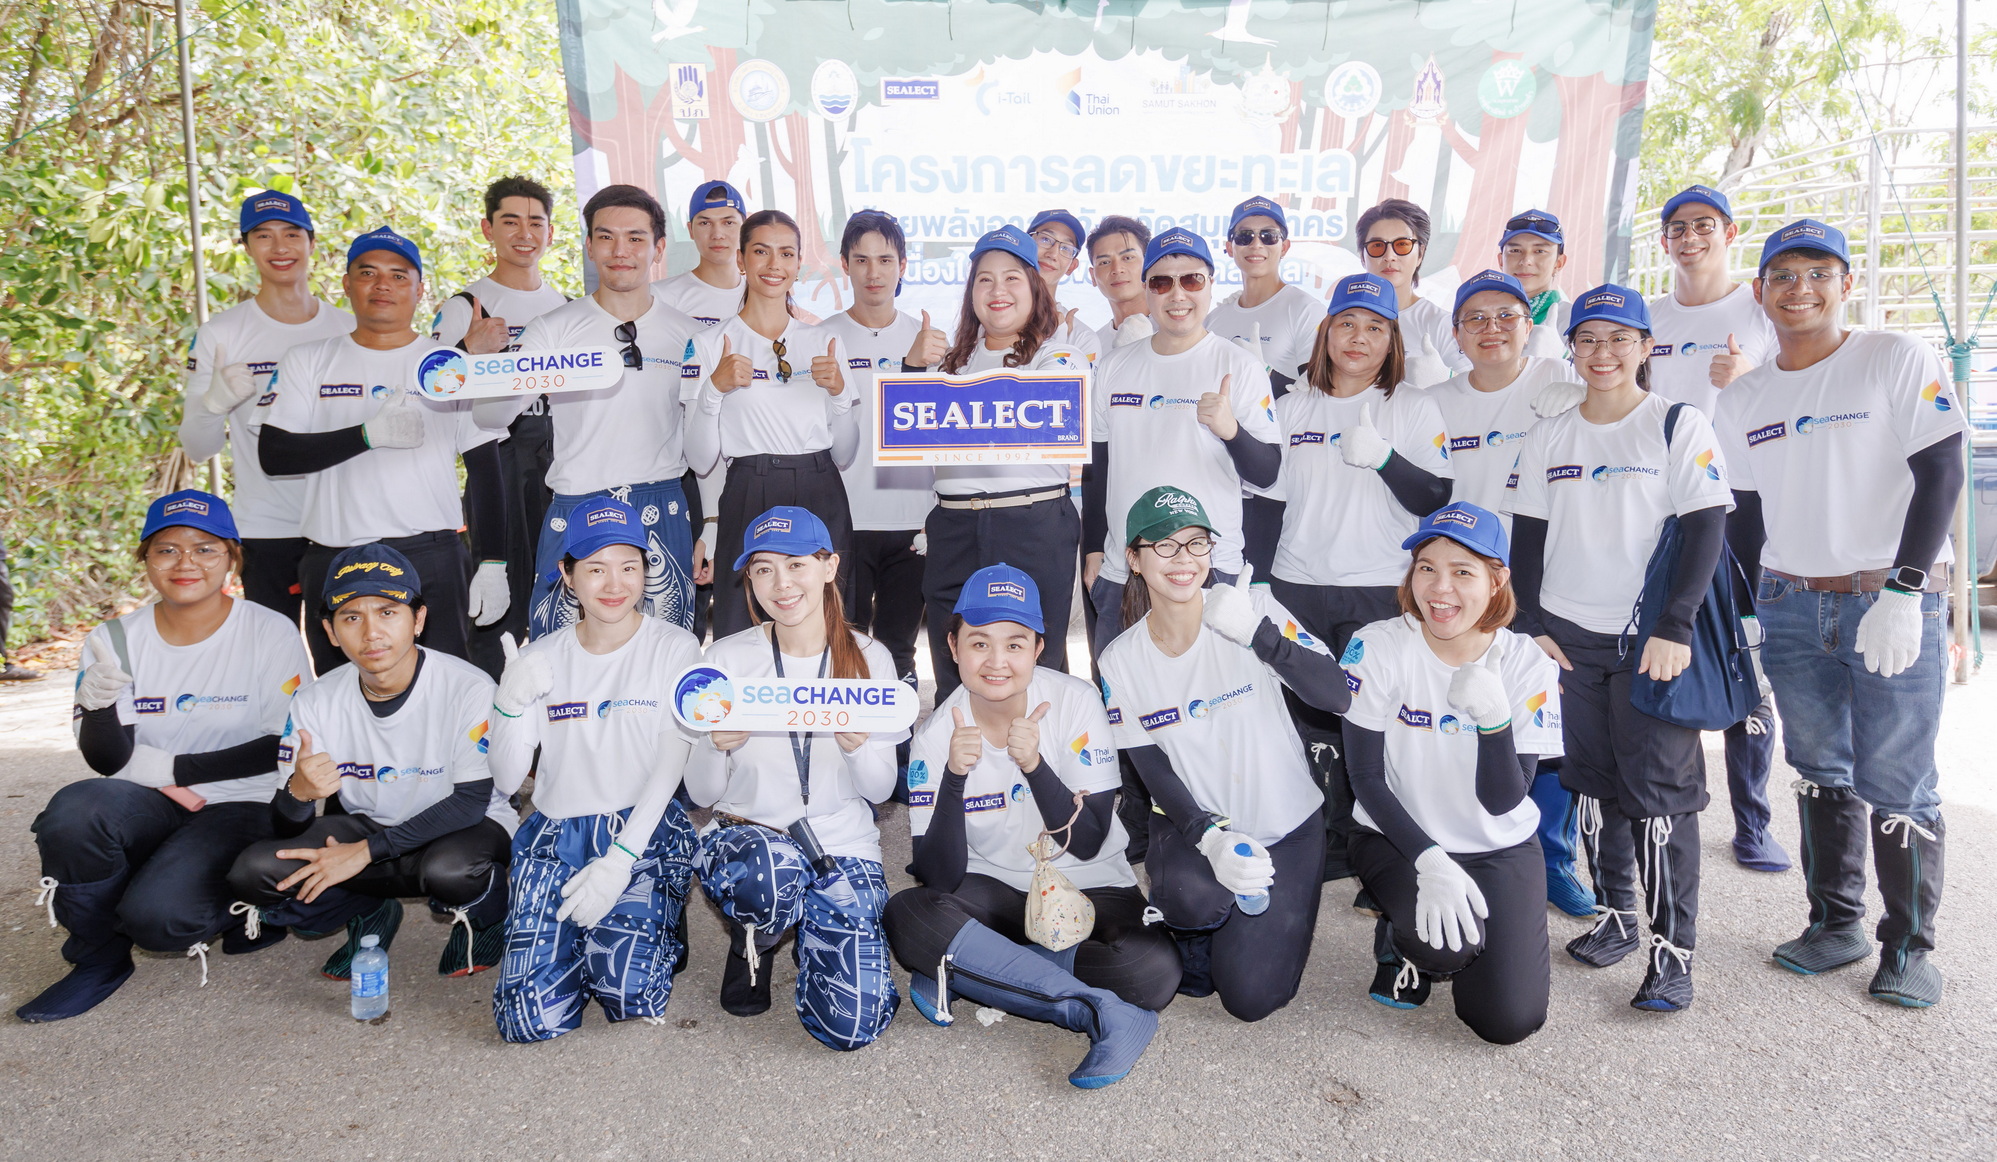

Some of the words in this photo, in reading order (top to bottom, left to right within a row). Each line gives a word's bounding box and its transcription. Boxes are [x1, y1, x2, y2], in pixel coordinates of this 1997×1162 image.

[886, 85, 937, 96] SEALECT
[998, 91, 1031, 104] i-Tail
[1086, 93, 1110, 105] Thai
[1142, 99, 1175, 108] SAMUT
[1177, 99, 1217, 108] SAKHON
[1087, 104, 1120, 116] Union
[850, 138, 1352, 194] โครงการลดขยะทะเล
[257, 200, 288, 209] SEALECT
[992, 232, 1018, 243] SEALECT
[1784, 227, 1822, 238] SEALECT
[1163, 236, 1191, 245] SEALECT
[1472, 274, 1503, 283] SEALECT
[1349, 283, 1378, 293] SEALECT
[1587, 295, 1622, 305] SEALECT
[1651, 347, 1671, 355] LECT
[474, 352, 604, 376] seaCHANGE
[642, 356, 683, 367] seaCHANGE
[848, 360, 870, 368] ALECT
[682, 368, 699, 377] LECT
[512, 375, 566, 391] 2030
[320, 387, 361, 396] SEALECT
[1111, 396, 1142, 405] SEALECT
[893, 400, 1071, 431] SEALECT
[1814, 412, 1870, 425] seaCHANGE
[1829, 421, 1853, 430] 2030
[1749, 426, 1783, 442] SEALECT
[934, 452, 984, 463] SINCE
[996, 451, 1032, 462] 1992
[1609, 466, 1659, 476] seaCHANGE
[166, 501, 206, 512] SEALECT
[589, 511, 624, 521] SEALECT
[1437, 512, 1474, 524] SEALECT
[756, 521, 790, 534] SEALECT
[991, 585, 1023, 596] SEALECT
[742, 685, 896, 706] seaCHANGE
[1208, 684, 1254, 708] seaCHANGE
[136, 701, 163, 710] LECT
[549, 706, 584, 718] SEALECT
[787, 710, 850, 727] 2030
[1142, 712, 1177, 728] SEALECT
[1094, 747, 1110, 757] Thai
[1095, 754, 1115, 765] Union
[909, 795, 932, 804] LECT
[965, 797, 1004, 810] SEALECT
